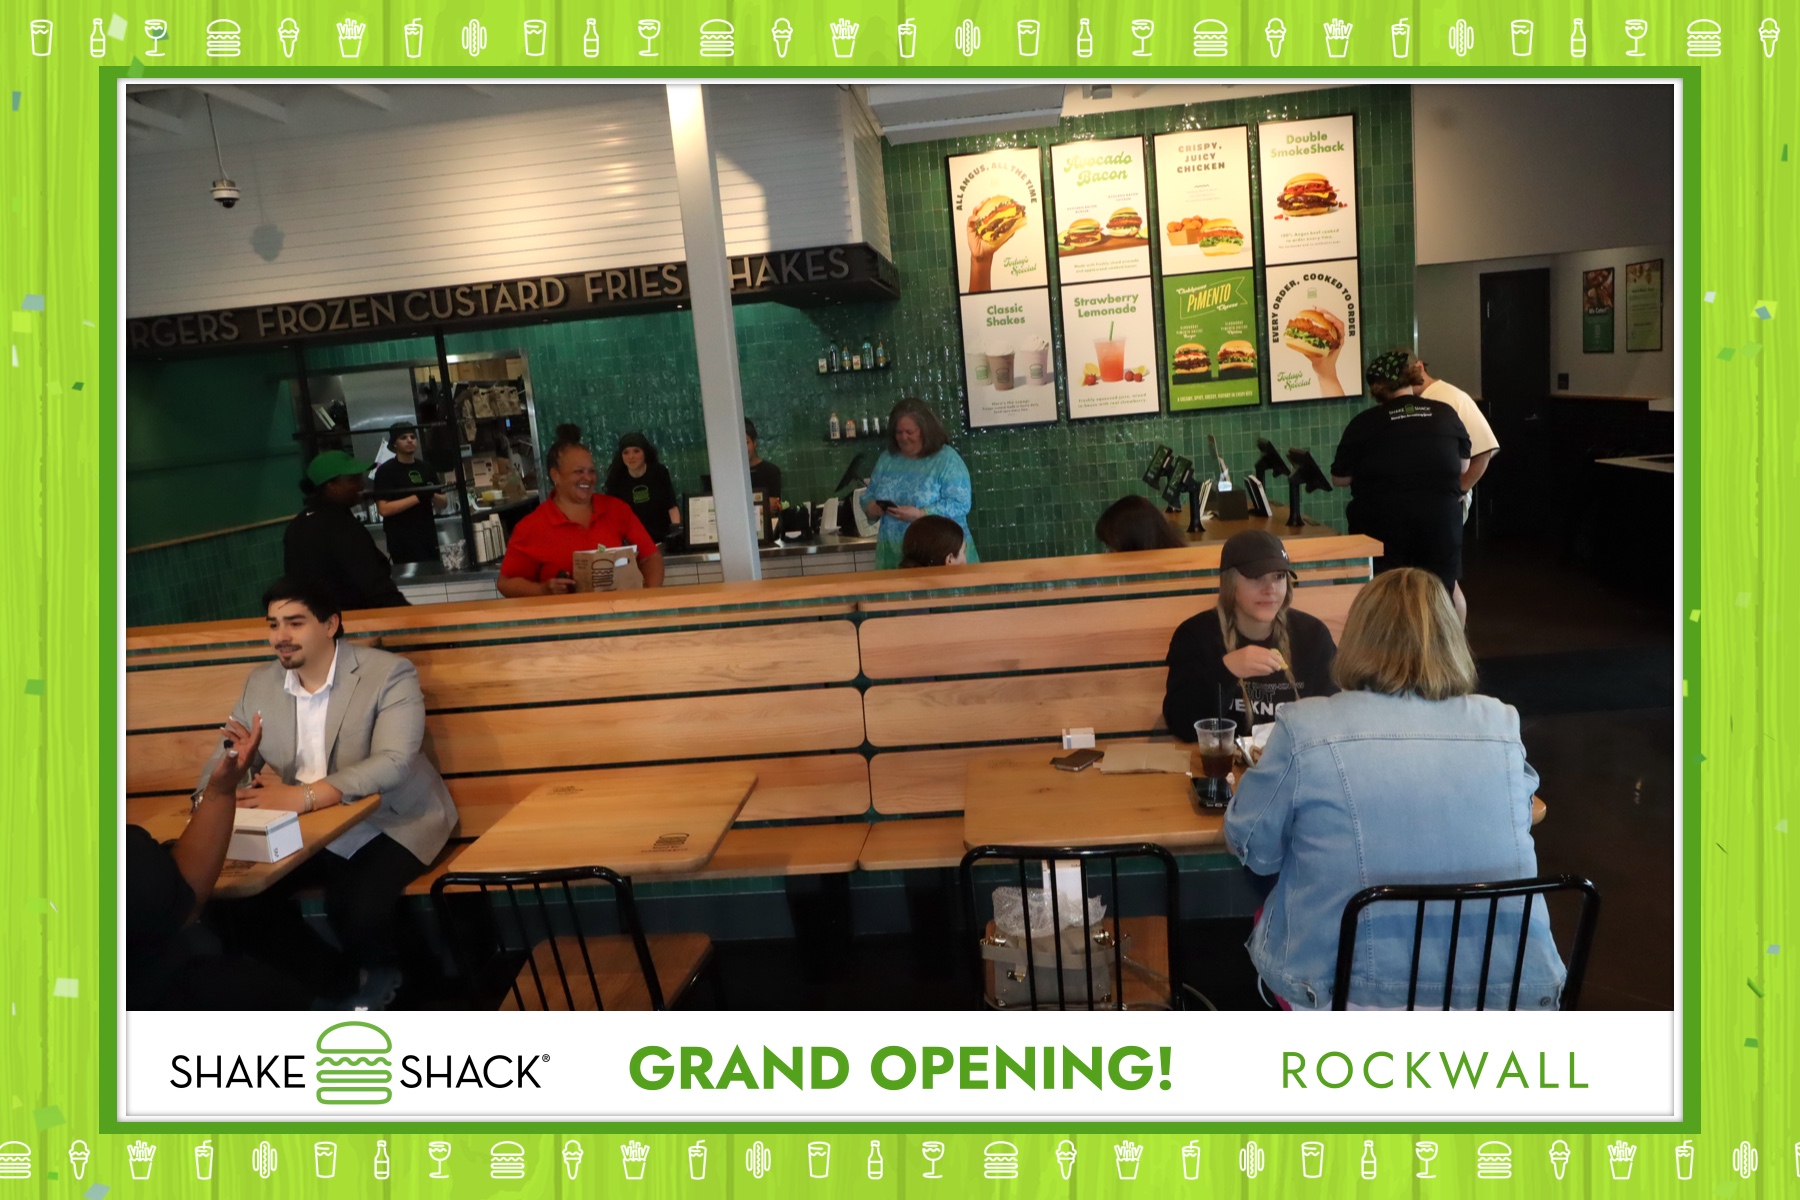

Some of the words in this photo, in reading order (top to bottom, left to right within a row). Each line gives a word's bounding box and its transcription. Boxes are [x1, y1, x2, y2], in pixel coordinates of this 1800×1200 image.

[1286, 131, 1328, 144] Double
[1178, 142, 1222, 153] CRISPY,
[1270, 141, 1345, 158] SmokeShack
[1063, 150, 1133, 173] Avocado
[1185, 152, 1216, 162] JUICY
[1176, 162, 1226, 174] CHICKEN
[1076, 169, 1128, 187] Bacon
[956, 193, 964, 211] ALL
[962, 164, 990, 192] ANGUS,
[991, 162, 1008, 170] ALL
[1010, 164, 1028, 181] THE
[1025, 179, 1038, 204] TIME
[728, 248, 849, 288] HAKES
[1004, 256, 1029, 268] Today's
[1010, 263, 1038, 277] Special
[1303, 273, 1343, 290] COOKED
[256, 294, 396, 338] FROZEN
[404, 276, 566, 322] CUSTARD
[585, 264, 683, 303] FRIES
[1074, 293, 1139, 307] Strawberry
[1272, 279, 1300, 310] ORDER,
[1342, 288, 1352, 302] TO
[986, 303, 1024, 315] Classic
[1078, 304, 1136, 318] Lemonade
[986, 315, 1026, 327] Shakes
[1348, 303, 1356, 337] ORDER
[1272, 312, 1280, 343] EVERY
[1277, 370, 1303, 382] Today's
[1284, 378, 1311, 391] Special
